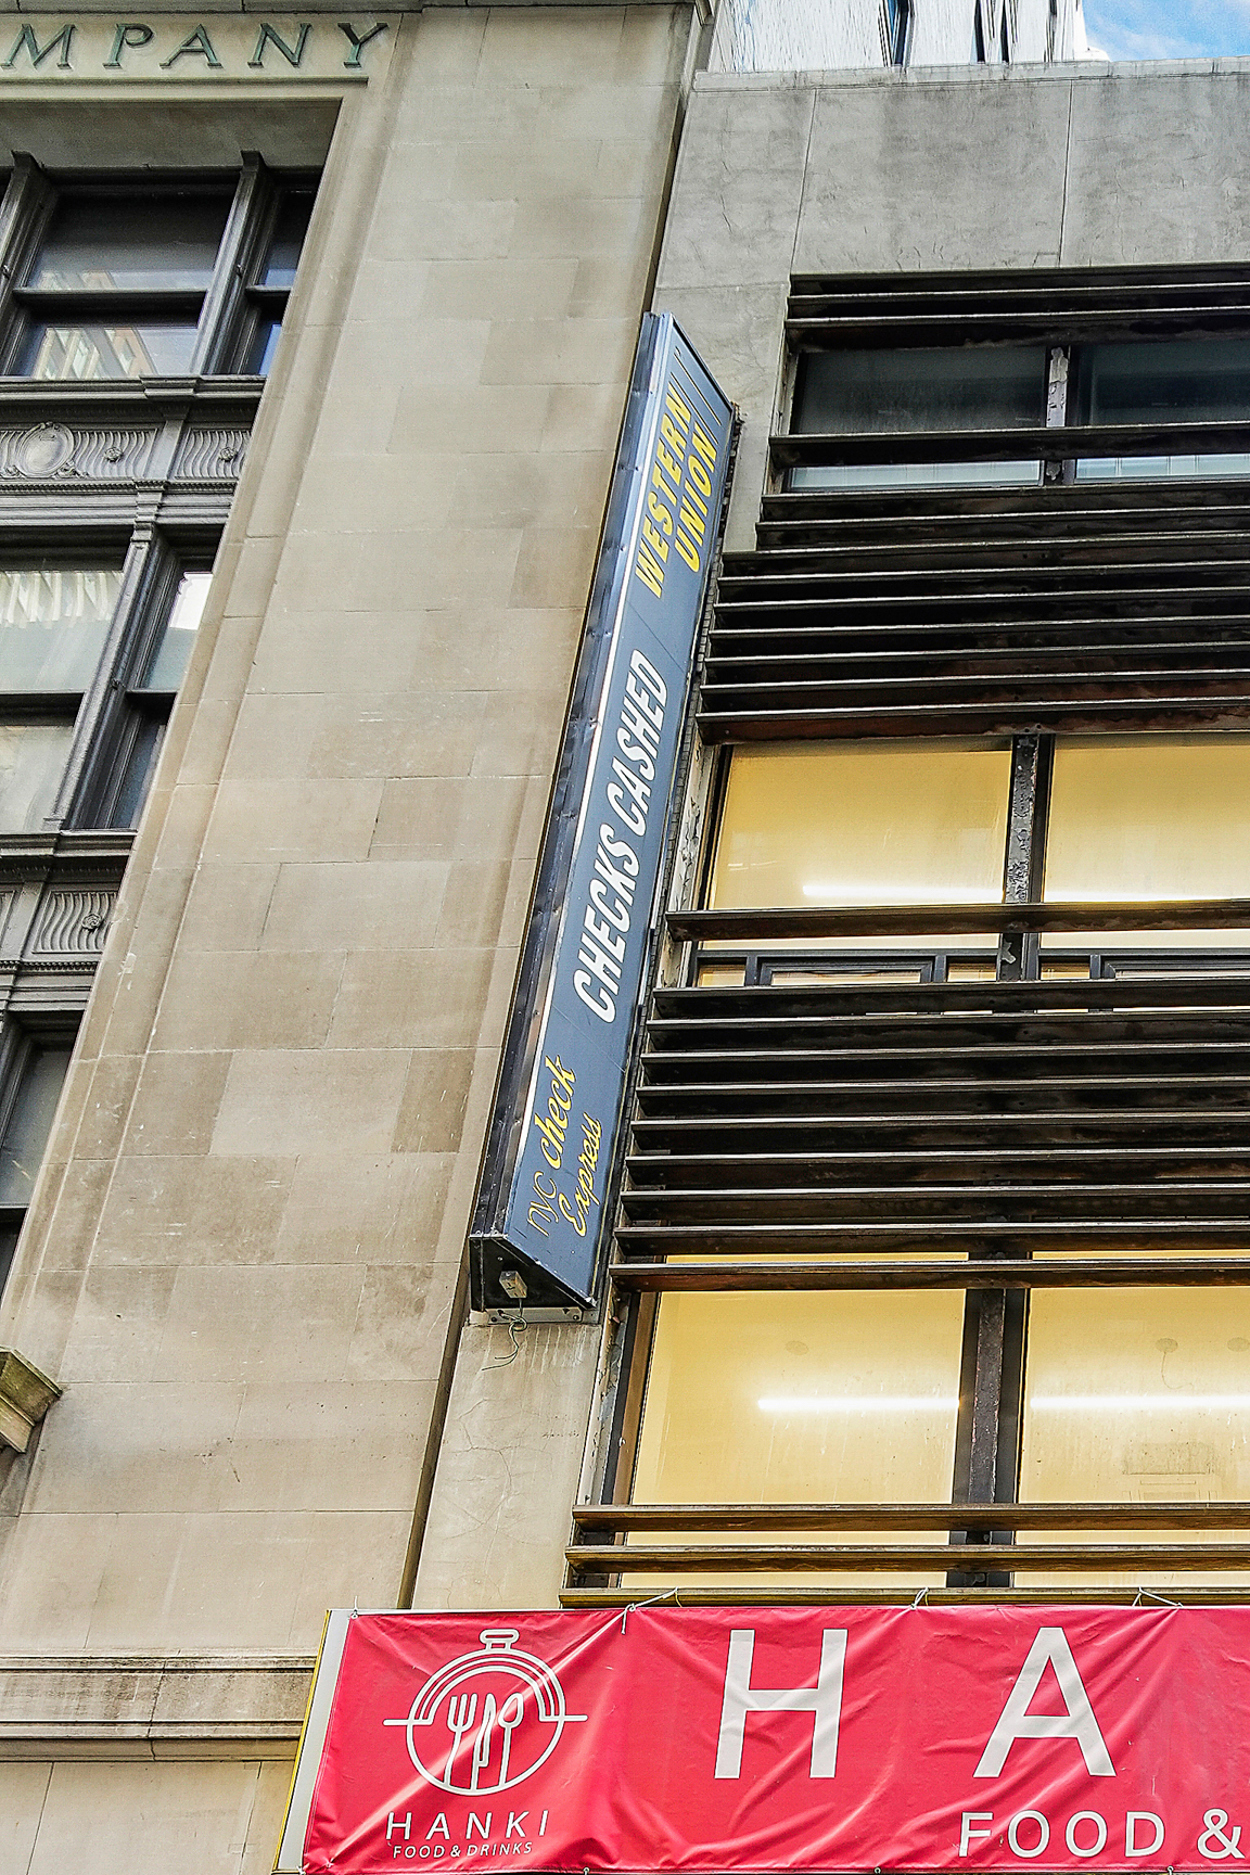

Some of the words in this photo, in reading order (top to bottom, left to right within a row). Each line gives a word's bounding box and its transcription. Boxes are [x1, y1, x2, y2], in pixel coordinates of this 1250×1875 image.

[1, 23, 389, 69] MPANY
[635, 383, 692, 598] WESTERN
[674, 422, 718, 573] UNION
[605, 648, 668, 837] CASHED
[573, 823, 640, 1023] CHECKS
[558, 1112, 603, 1238] Express
[385, 1810, 549, 1840] HANKI
[393, 1844, 445, 1859] FOOD
[450, 1845, 461, 1858] &
[466, 1841, 533, 1857] DRINKS
[958, 1809, 1165, 1859] FOOD
[1197, 1808, 1245, 1860] &
